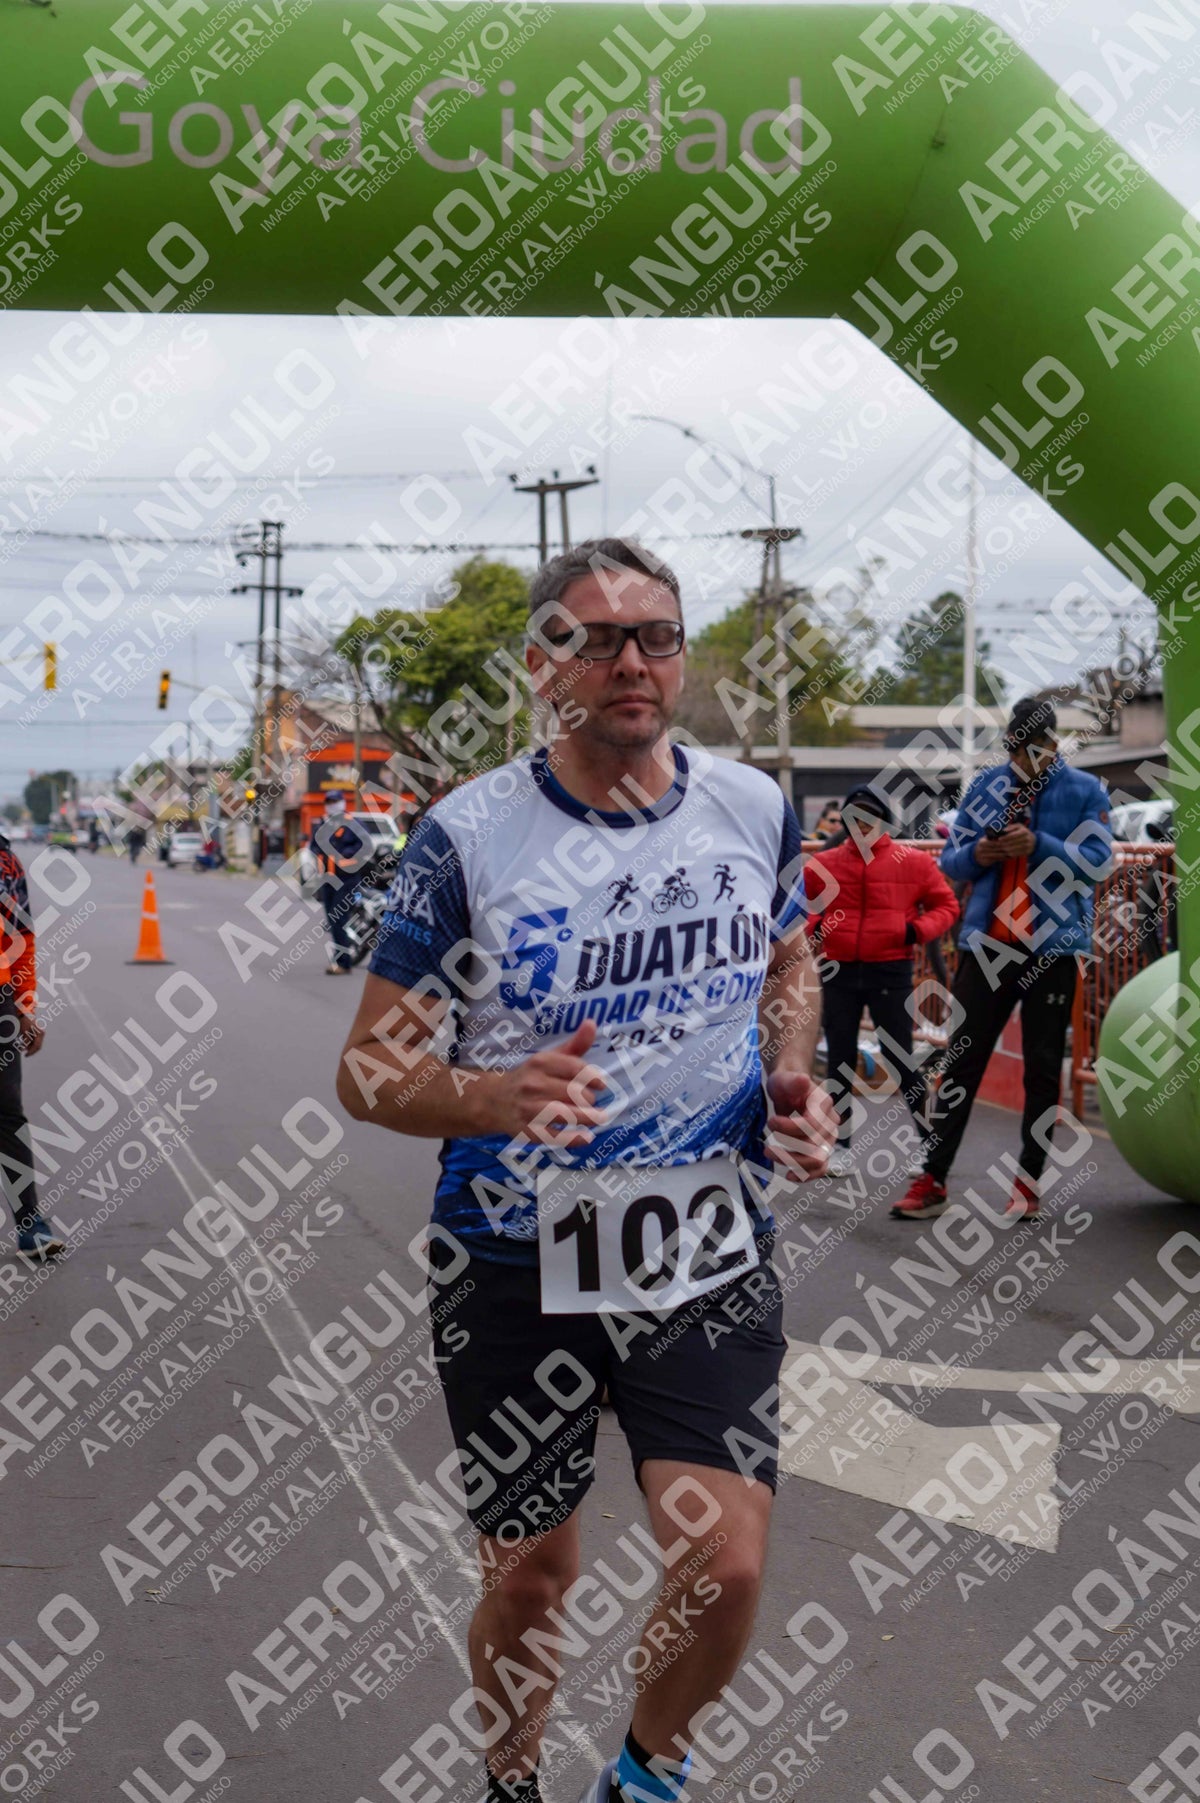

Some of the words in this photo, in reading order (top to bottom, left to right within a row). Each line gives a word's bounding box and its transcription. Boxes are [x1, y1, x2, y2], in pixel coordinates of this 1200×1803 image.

[69, 70, 362, 198] Goya
[409, 76, 803, 175] Ciudad
[571, 904, 769, 993] DUATLÓN
[536, 990, 650, 1037] CIUDAD
[656, 978, 699, 1017] DE
[607, 1022, 686, 1053] 2026
[553, 1184, 747, 1293] 102
